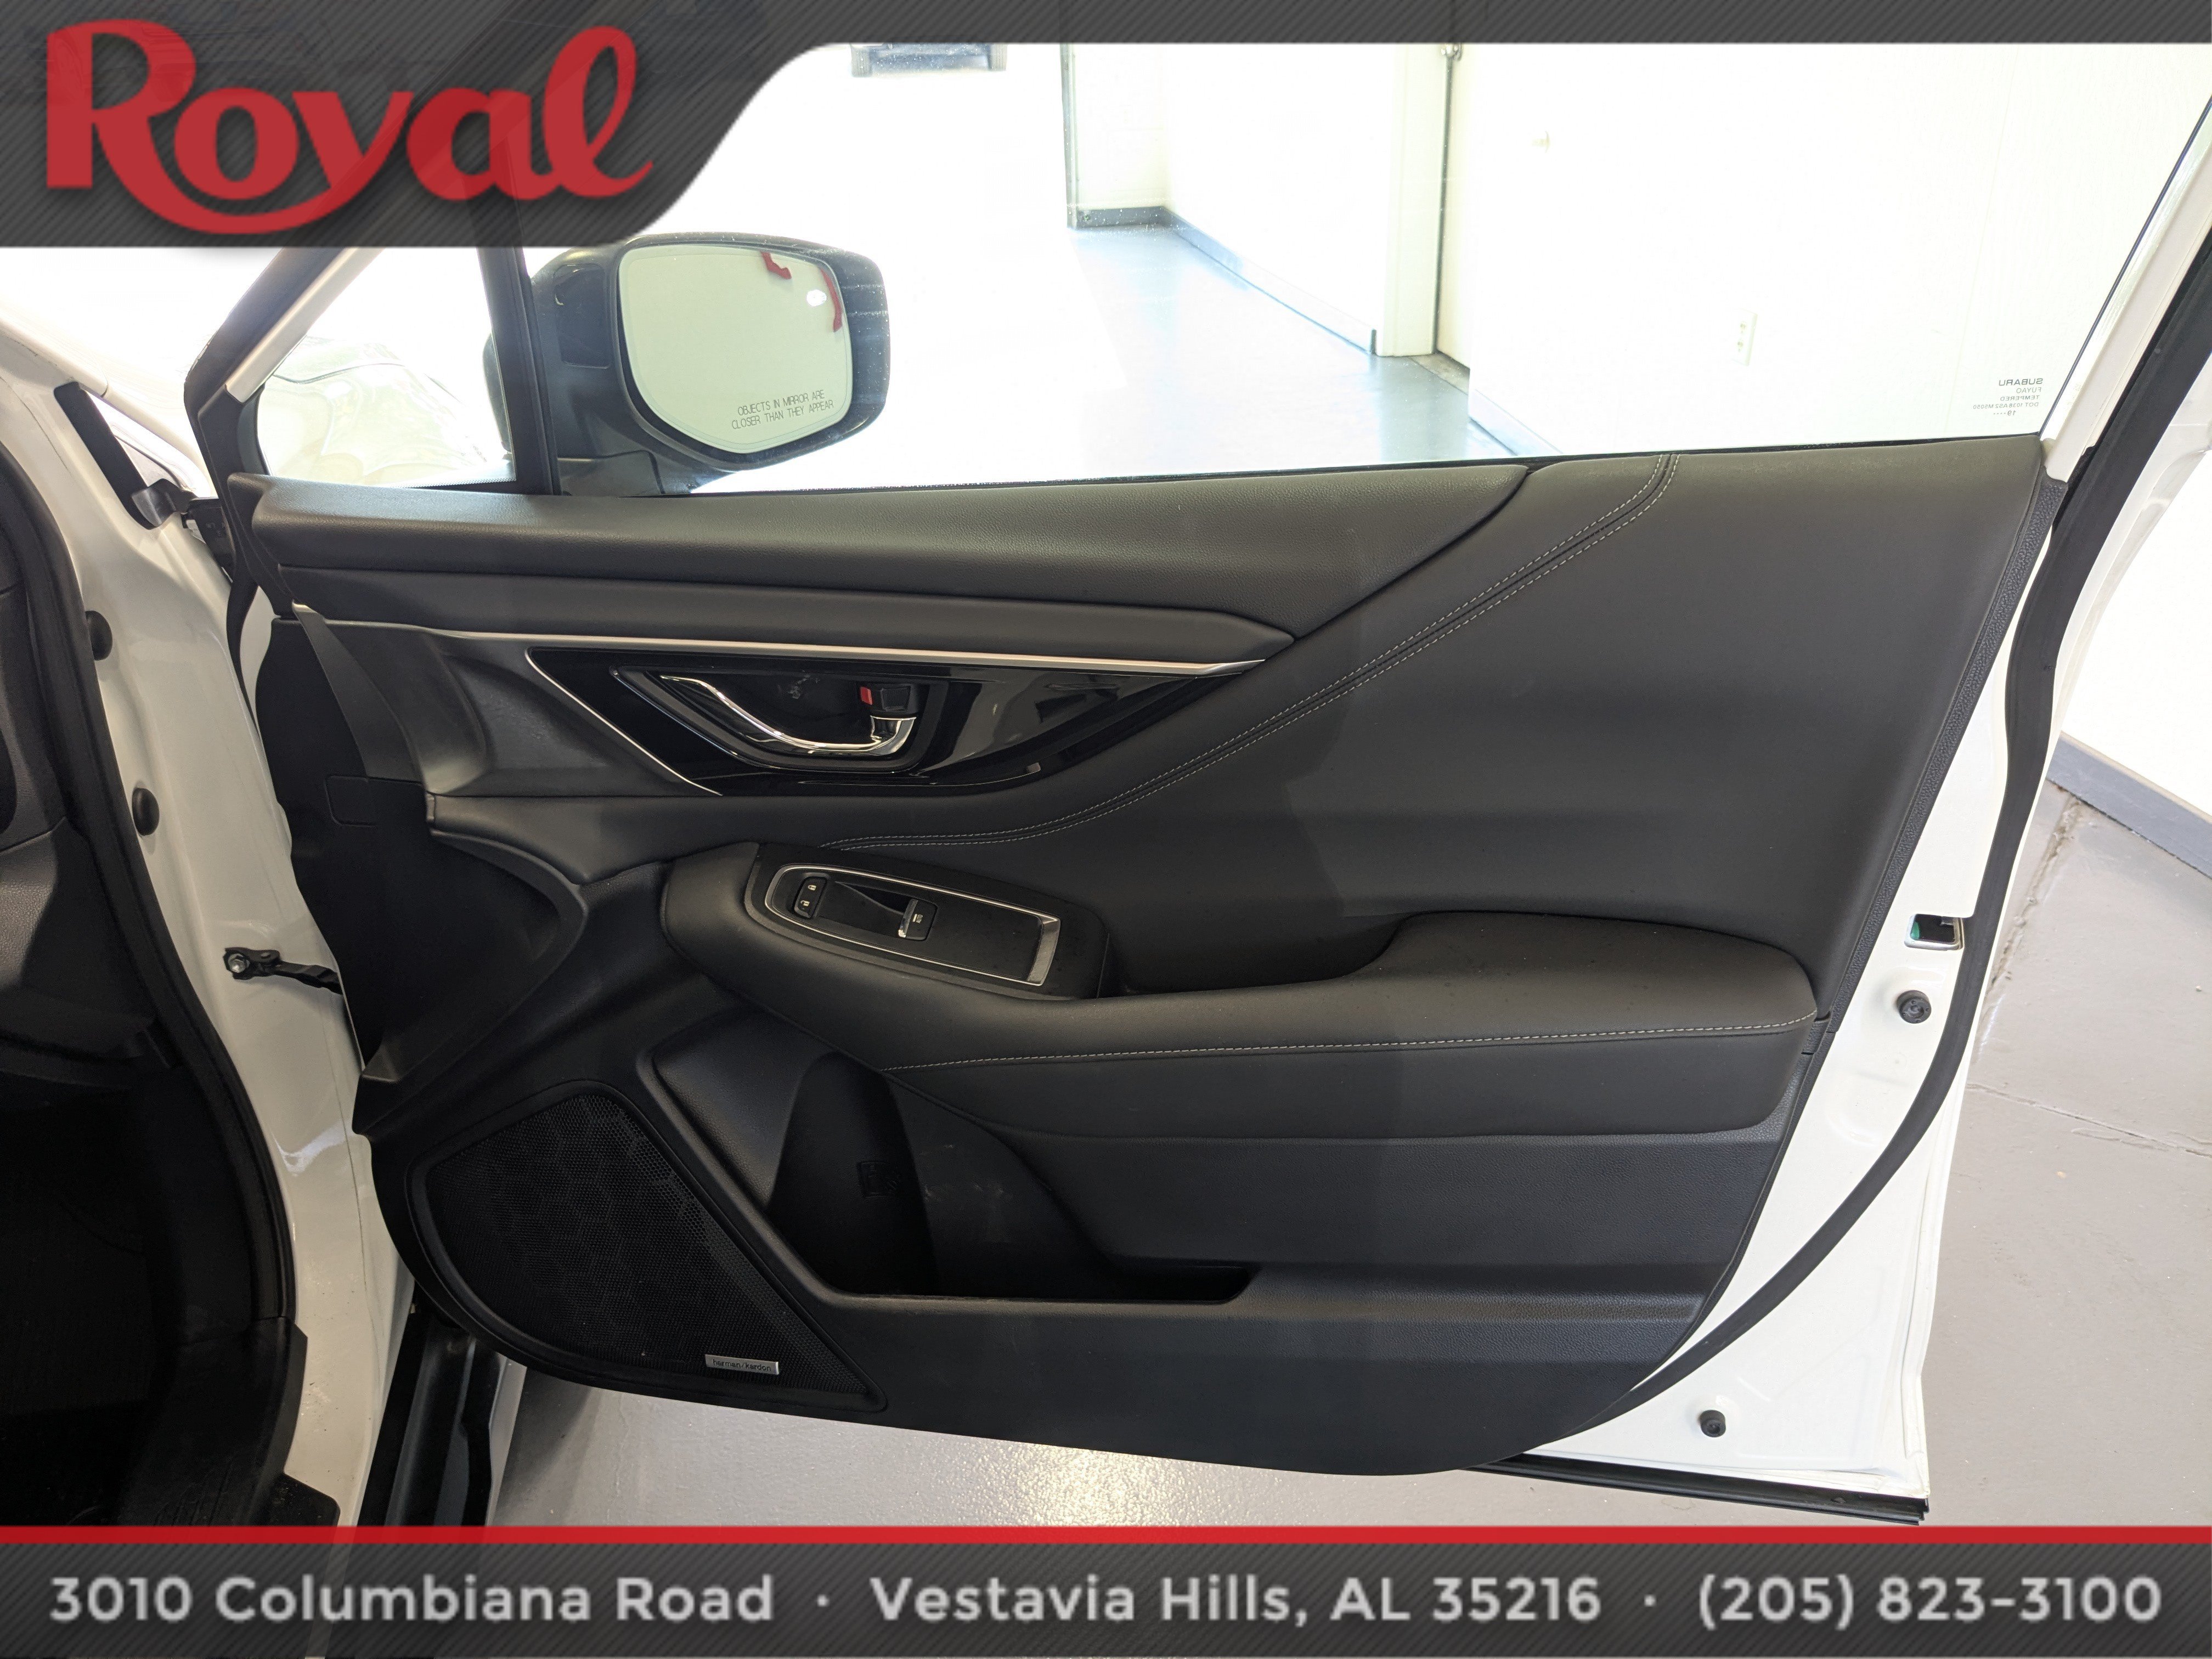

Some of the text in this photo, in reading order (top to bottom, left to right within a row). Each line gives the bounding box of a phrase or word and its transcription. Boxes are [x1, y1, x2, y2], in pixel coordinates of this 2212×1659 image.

[731, 399, 834, 430] CLOSER THAN THEY APPEAR
[738, 390, 825, 416] OBJECTS IN MIRROR ARE
[713, 1359, 771, 1372] harman/kardon
